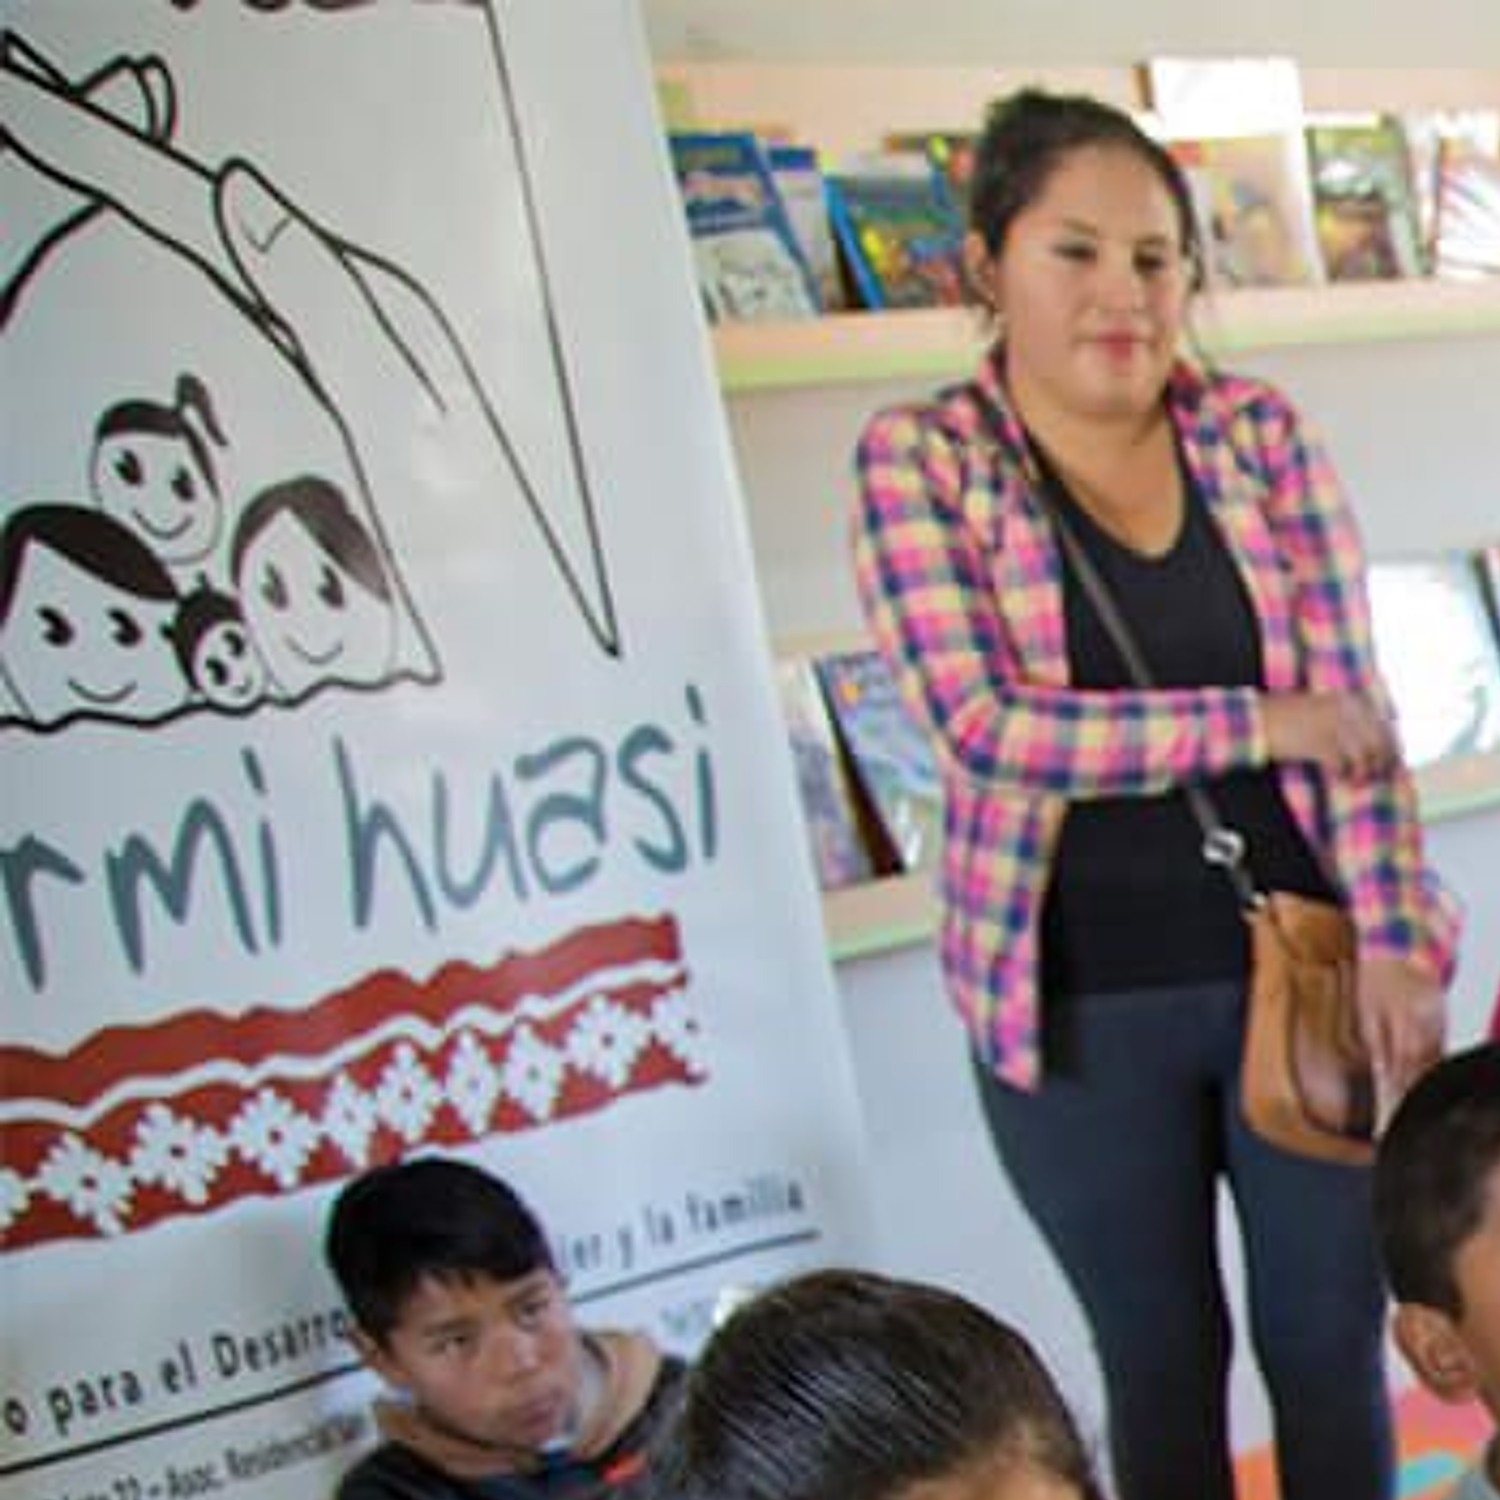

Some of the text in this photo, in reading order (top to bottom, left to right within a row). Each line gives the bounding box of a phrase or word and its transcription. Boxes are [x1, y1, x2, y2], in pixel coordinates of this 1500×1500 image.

[0, 684, 718, 991] rmi huasi
[615, 1223, 634, 1270] y
[642, 1202, 675, 1246] la
[47, 1370, 142, 1435] para
[160, 1337, 198, 1394] el
